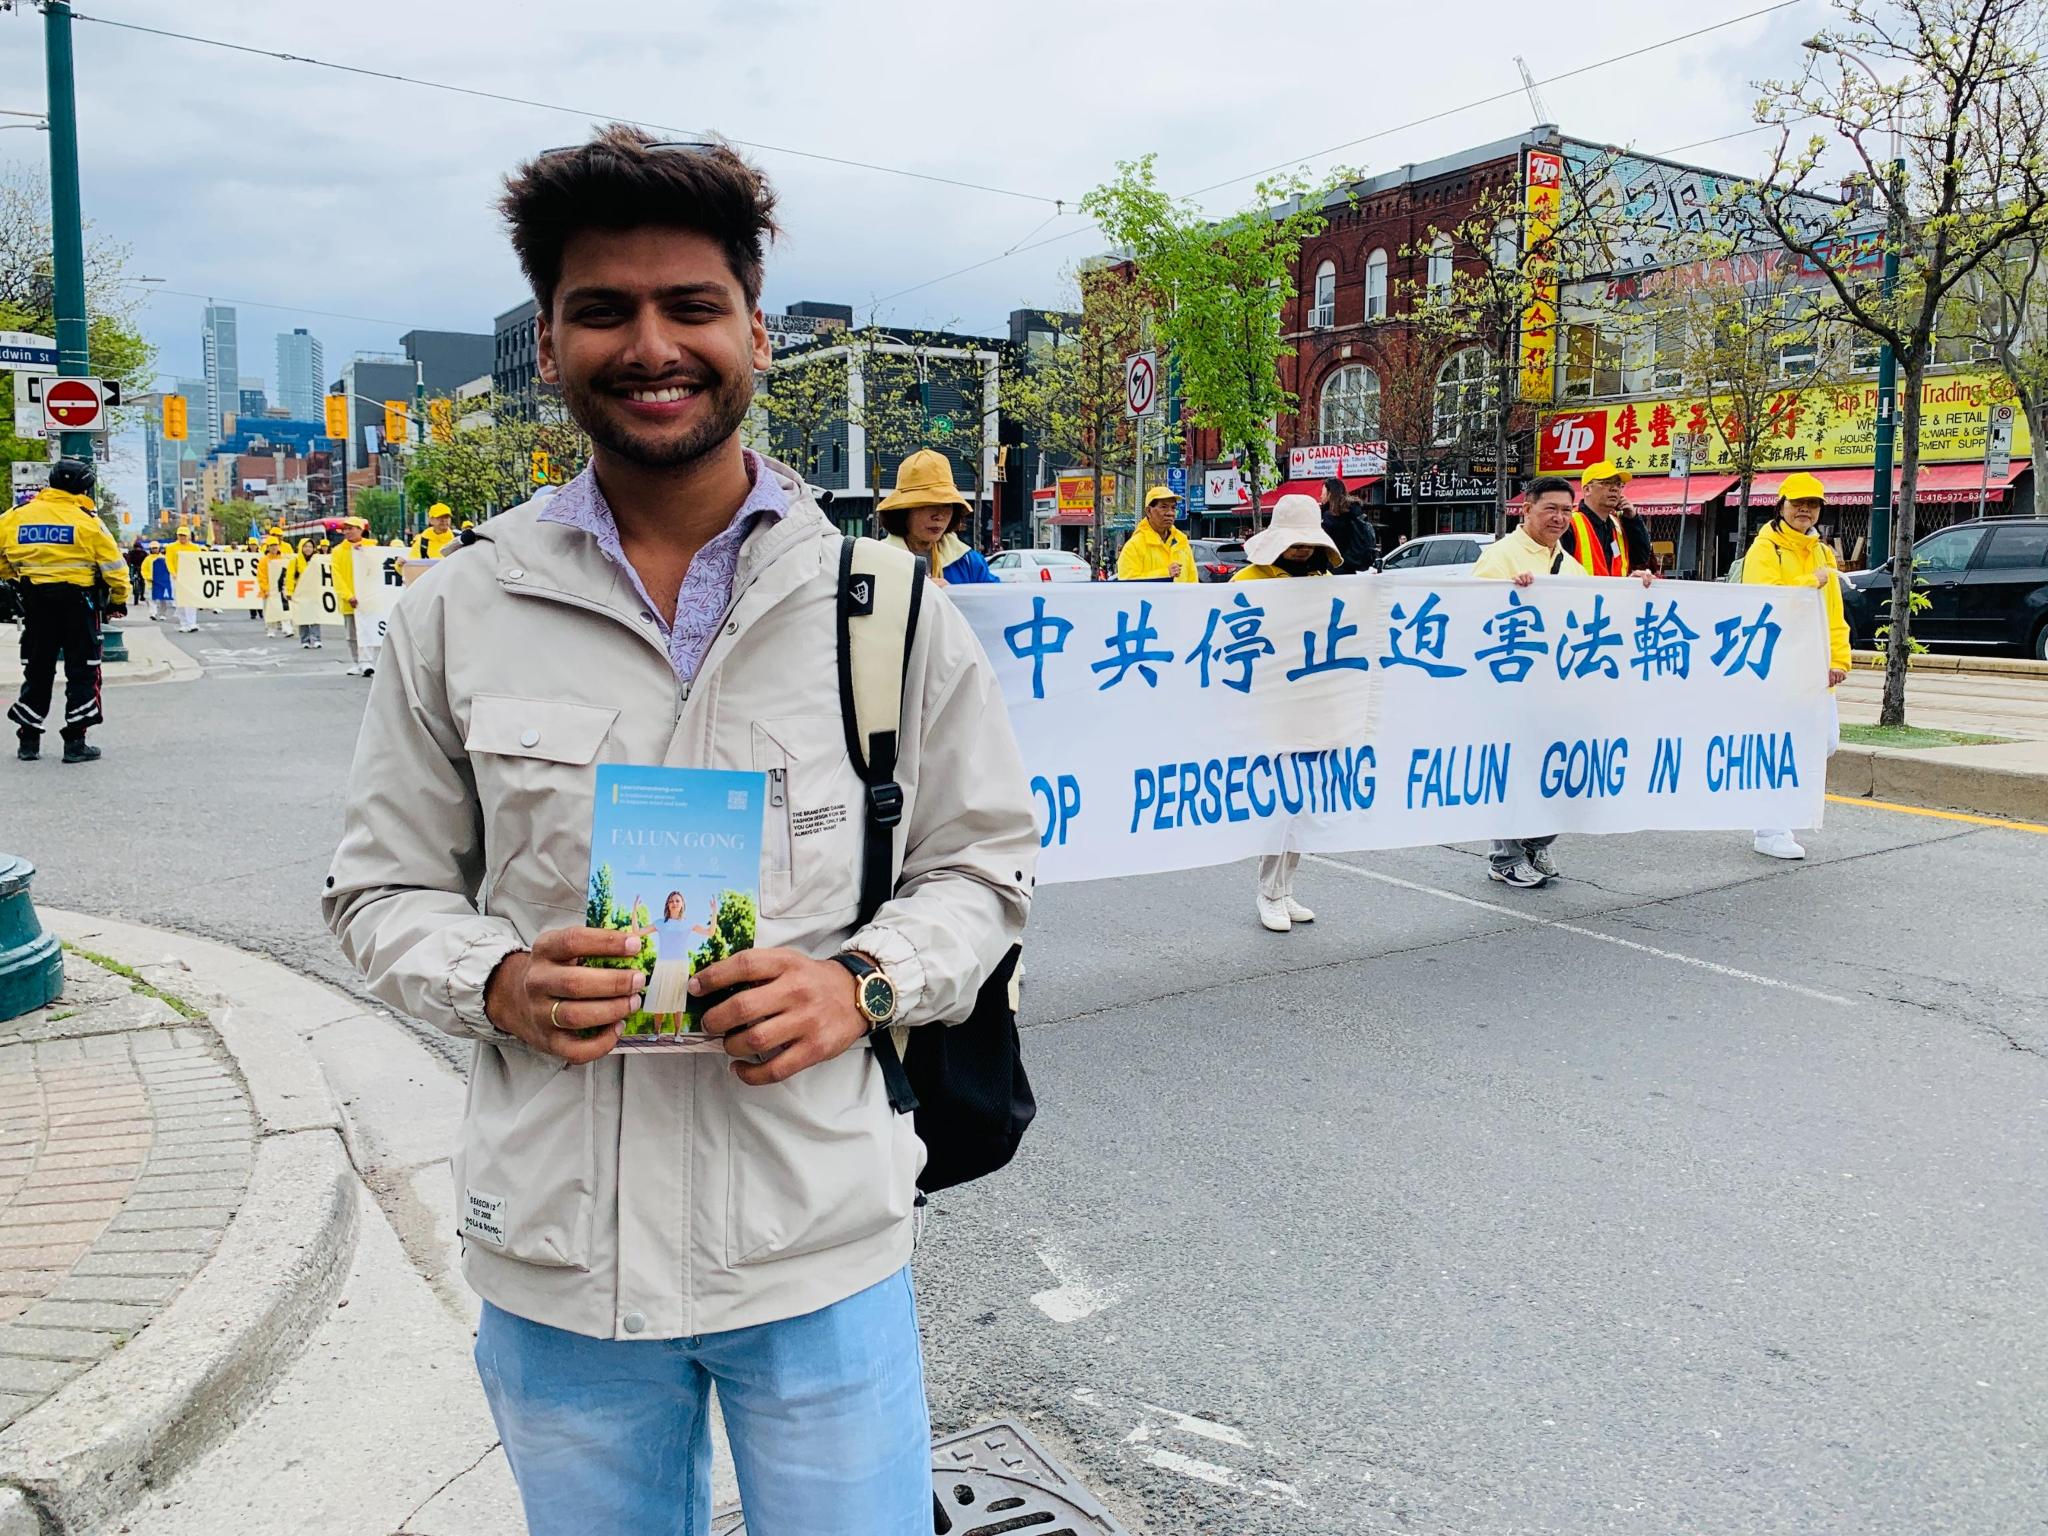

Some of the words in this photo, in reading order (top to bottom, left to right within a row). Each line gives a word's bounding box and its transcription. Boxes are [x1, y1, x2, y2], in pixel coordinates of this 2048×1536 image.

[0, 348, 32, 361] dwin
[40, 352, 49, 362] St
[1921, 381, 1982, 407] Trading
[1946, 412, 1986, 424] RETAIL
[1308, 445, 1350, 459] CANADA
[1354, 442, 1386, 456] GIFTS
[1842, 494, 1873, 503] SPADIN
[19, 527, 69, 543] POLICE
[199, 557, 244, 576] HELP
[203, 580, 224, 598] OF
[1004, 591, 1782, 699] 中共停止迫害法輪功
[1031, 774, 1081, 848] OP
[1130, 745, 1377, 833] PERSECUTING
[1407, 743, 1511, 809] FALUN
[1540, 737, 1628, 799] GONG
[1648, 737, 1681, 793] IN
[1706, 732, 1799, 792] CHINA
[611, 828, 681, 848] FALUN
[684, 831, 745, 851] GONG
